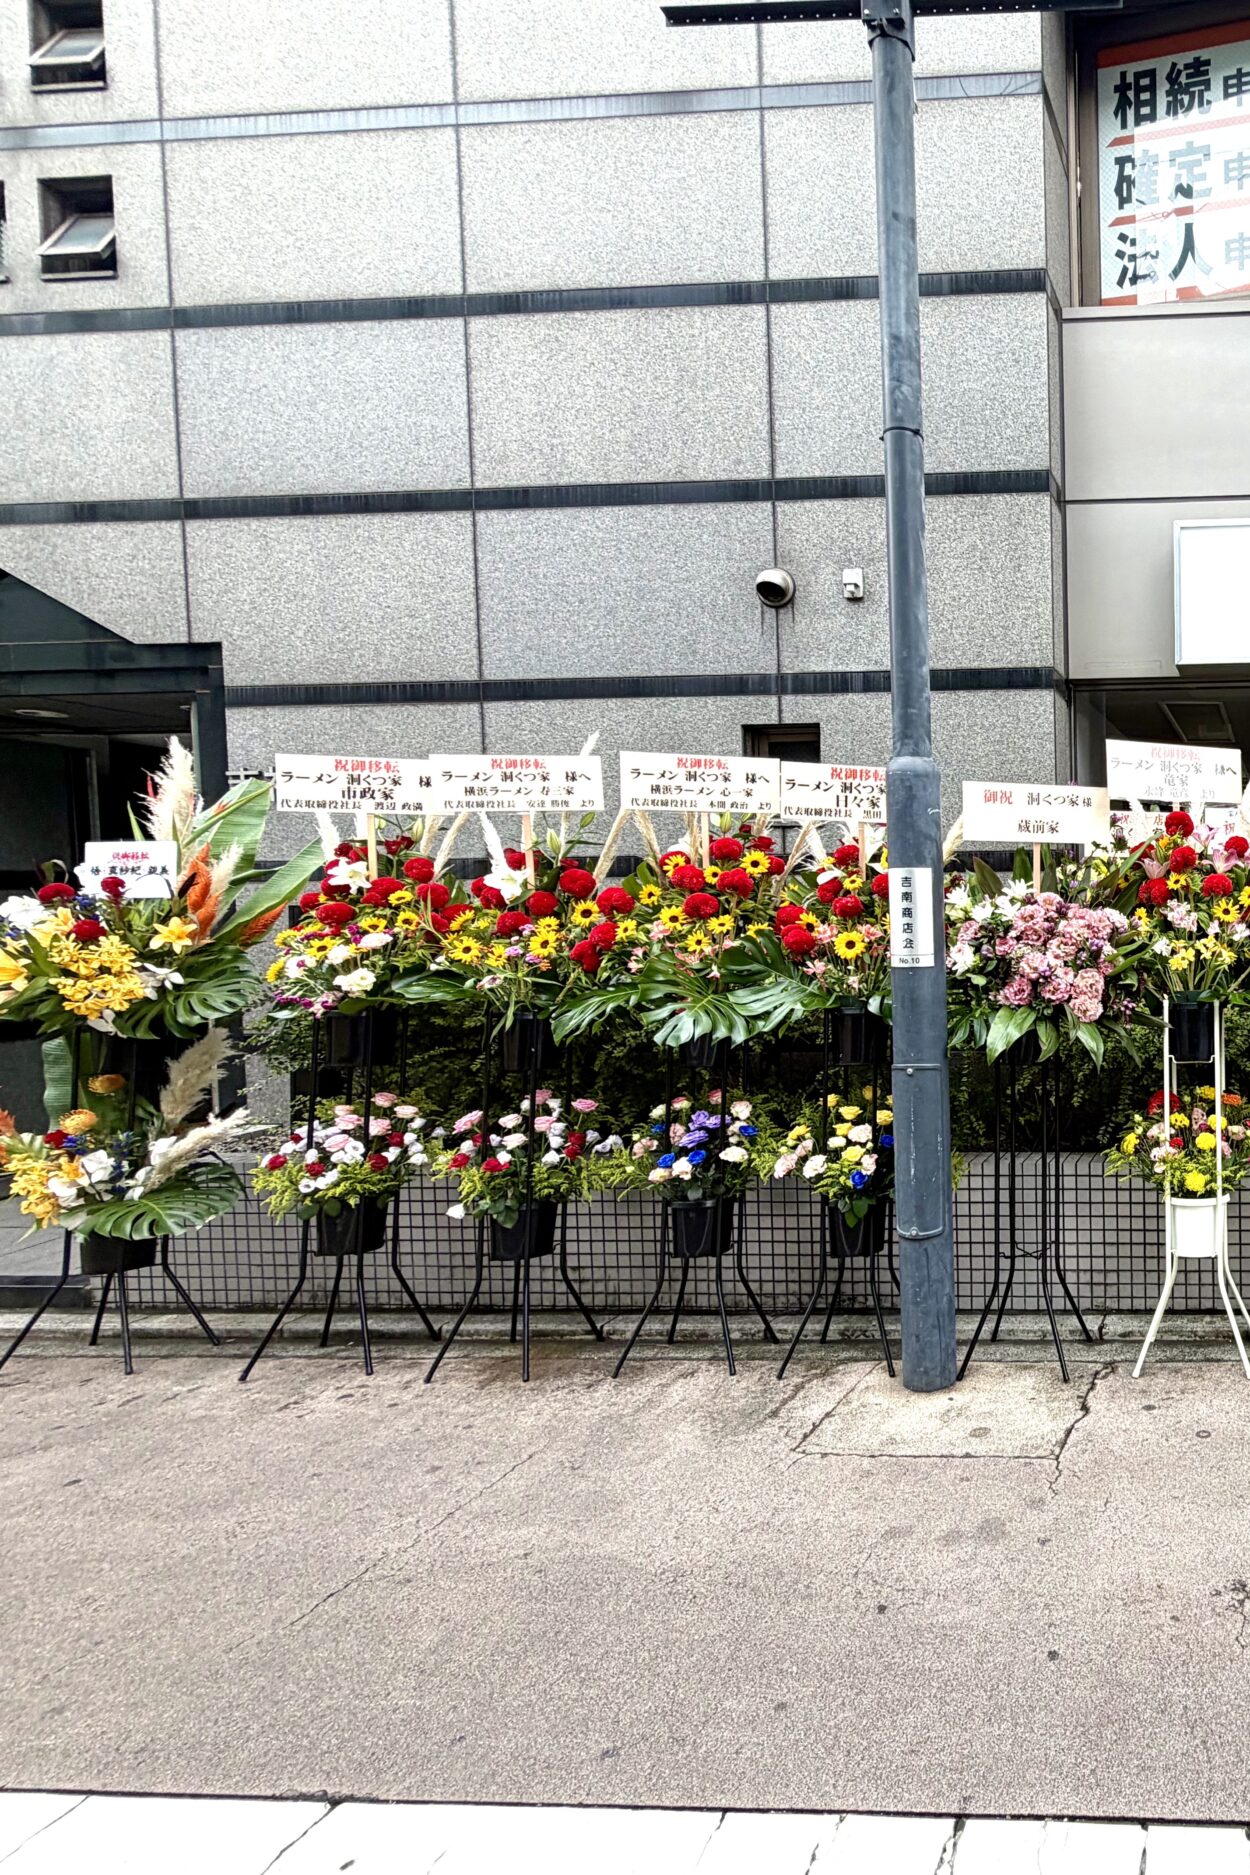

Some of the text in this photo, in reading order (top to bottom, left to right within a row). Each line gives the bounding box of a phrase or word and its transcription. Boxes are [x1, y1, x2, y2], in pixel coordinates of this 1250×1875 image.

[1111, 757, 1154, 770] ラーメン
[281, 771, 338, 784] ラーメン
[347, 773, 402, 787] 洞くつ家
[442, 771, 493, 782] ラーメン
[500, 771, 550, 782] 洞くつ家
[630, 768, 678, 780] ラーメン
[685, 770, 732, 783] 洞くつ家
[464, 786, 534, 797] 横浜ラーメン
[651, 784, 715, 796] 横浜ラーメン
[785, 779, 834, 792] ラーメン
[983, 789, 1013, 805] 御祝
[281, 799, 362, 810] 代表取締役社長
[758, 802, 771, 810] より
[784, 806, 852, 818] 代表取締役社長
[900, 876, 914, 949] 吉南商店会
